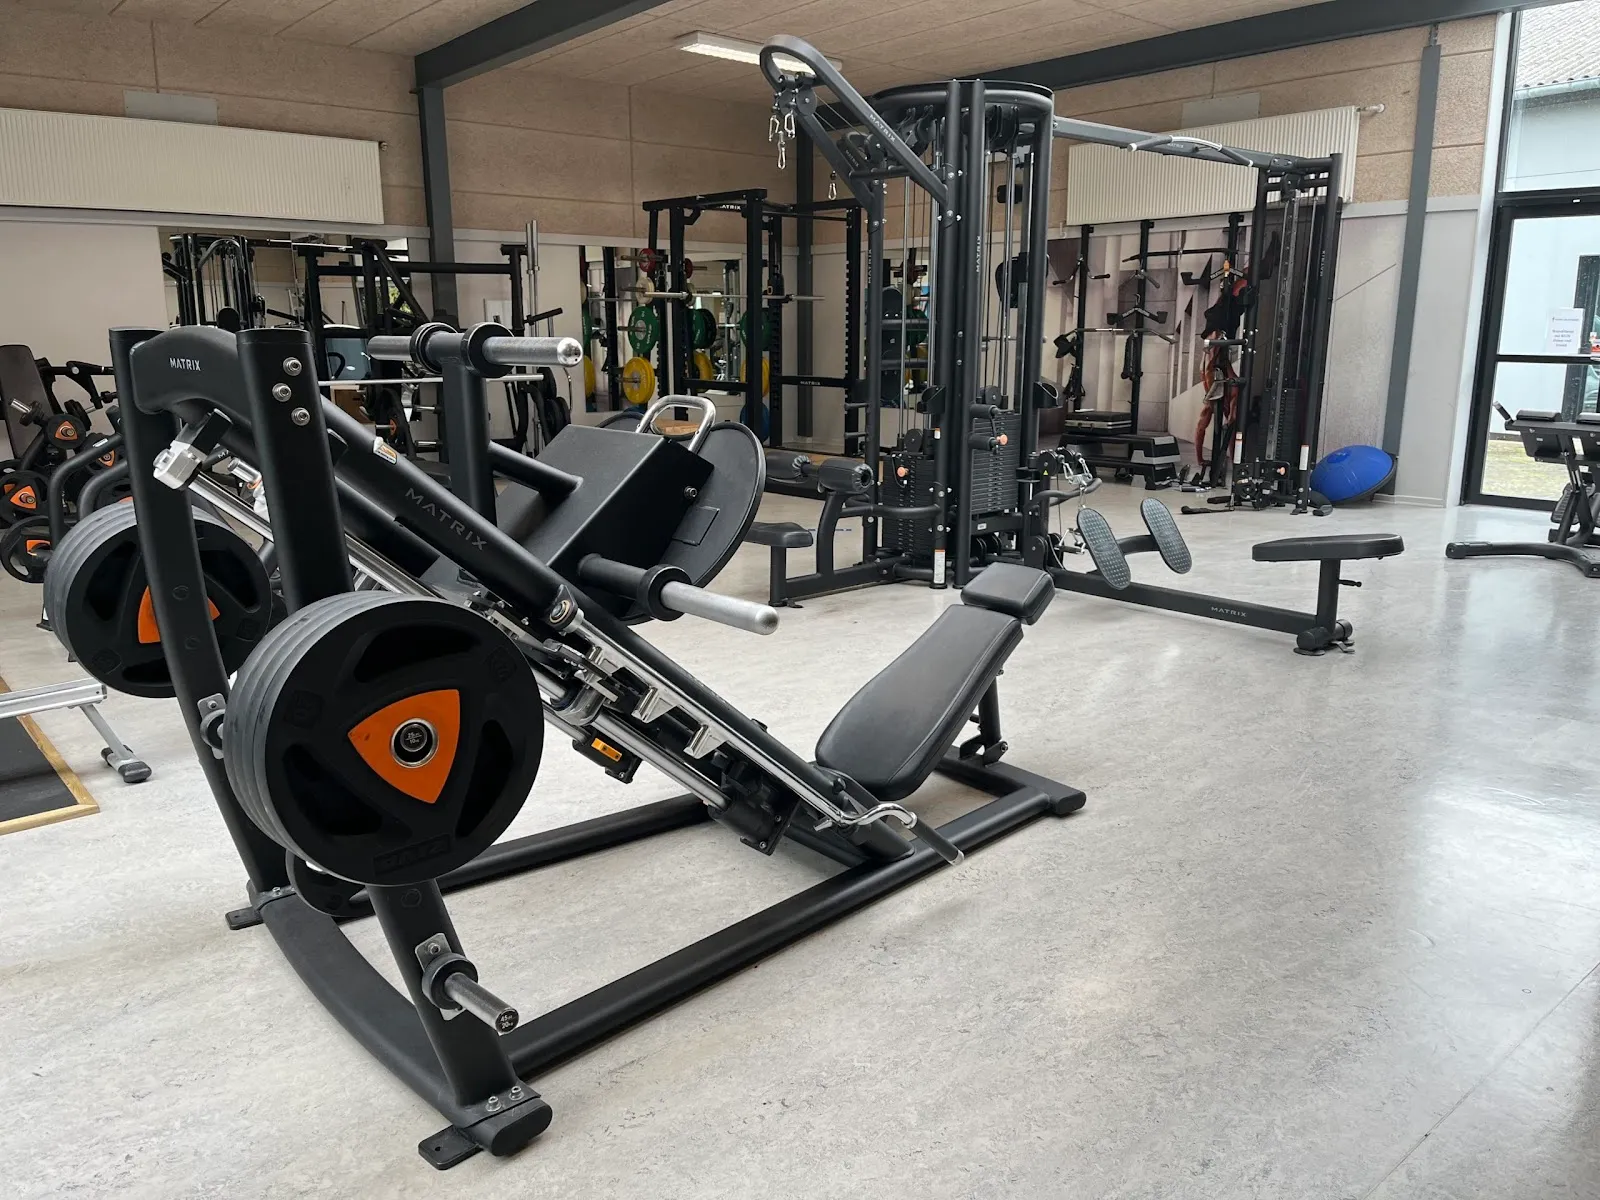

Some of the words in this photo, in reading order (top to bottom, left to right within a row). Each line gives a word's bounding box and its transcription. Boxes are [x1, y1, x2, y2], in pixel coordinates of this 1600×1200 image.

[870, 114, 895, 143] MATRIX
[169, 357, 201, 372] MATRIX
[404, 487, 488, 551] MATRIX
[1211, 606, 1247, 618] MATRIX
